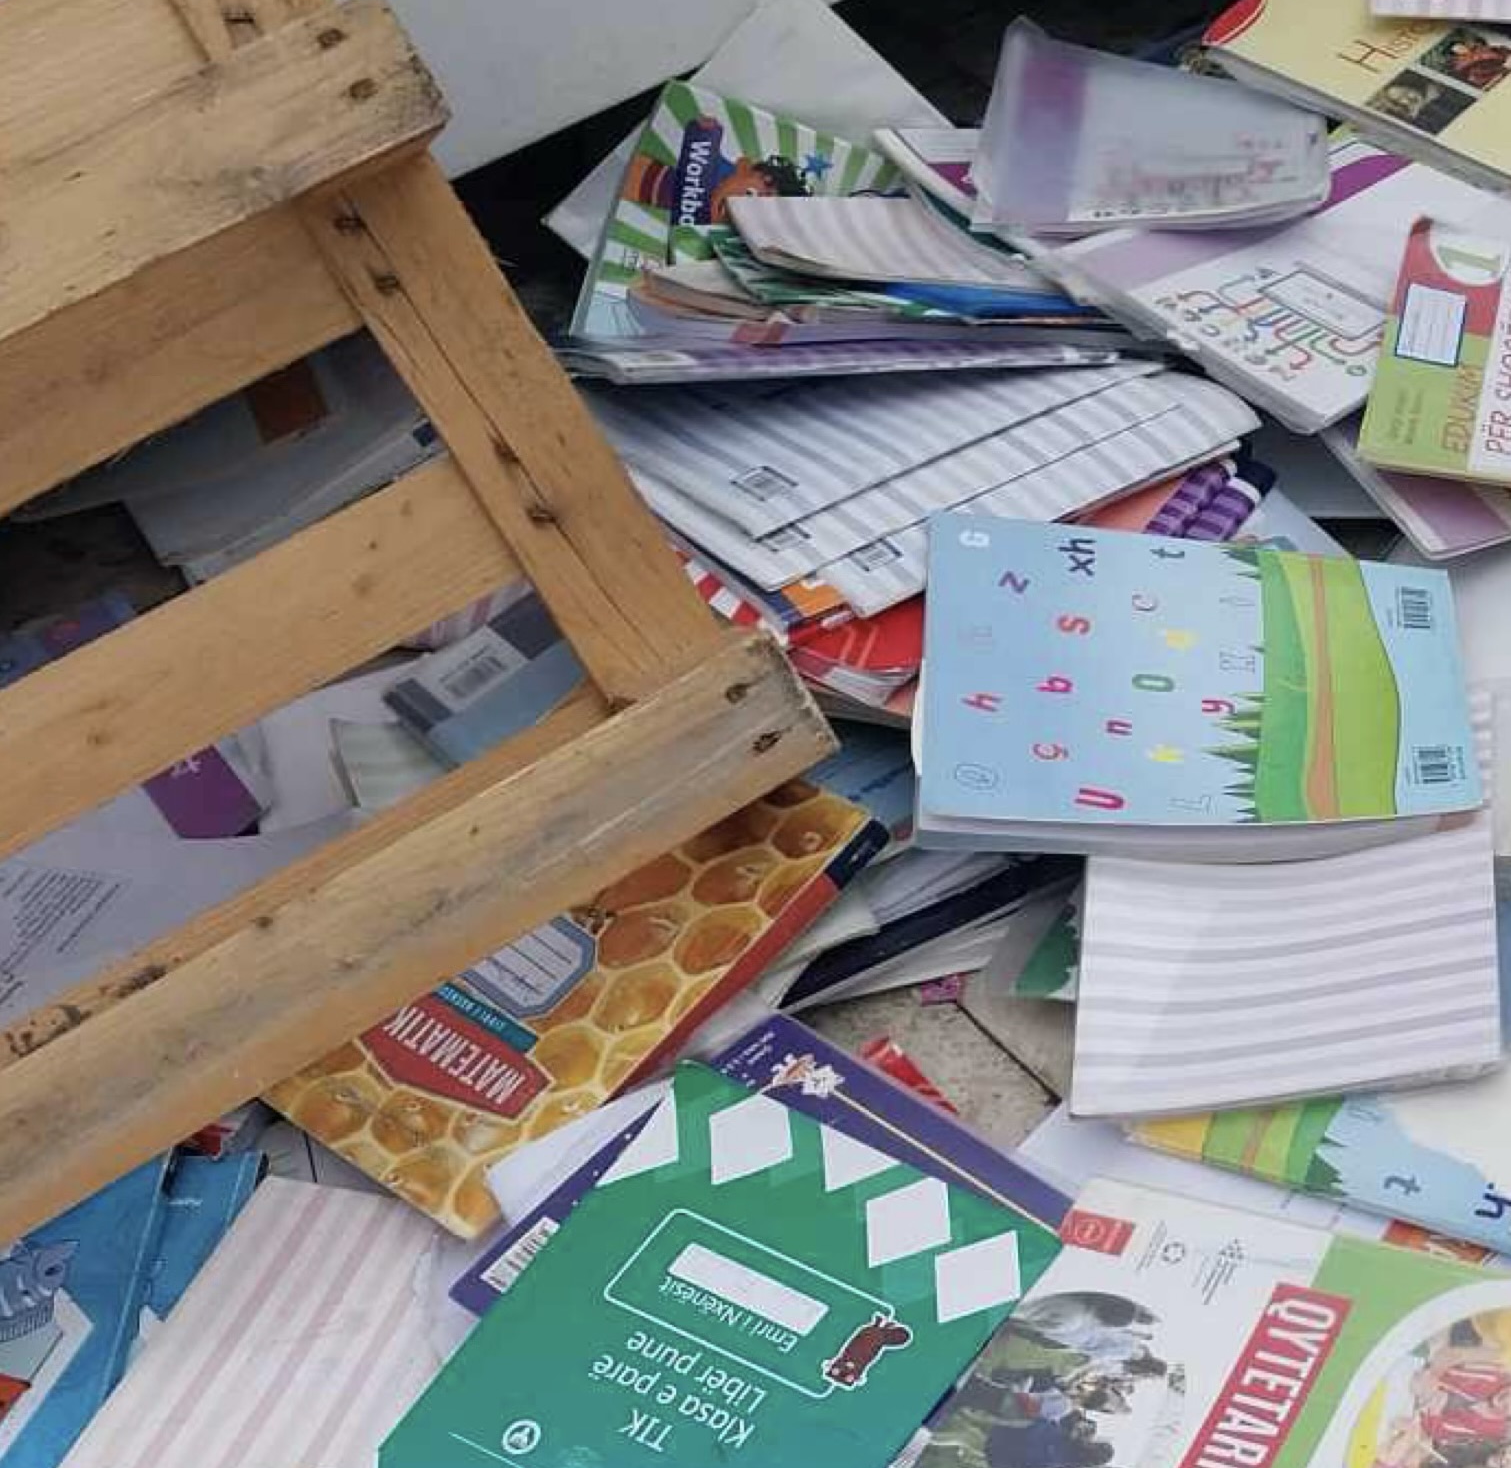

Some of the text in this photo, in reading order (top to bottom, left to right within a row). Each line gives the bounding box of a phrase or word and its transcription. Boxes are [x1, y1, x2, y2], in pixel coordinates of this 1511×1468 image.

[626, 1330, 768, 1414] Libër pune
[760, 1327, 799, 1353] Emri
[587, 1354, 756, 1449] Klasa e parë
[618, 1407, 673, 1454] TIK
